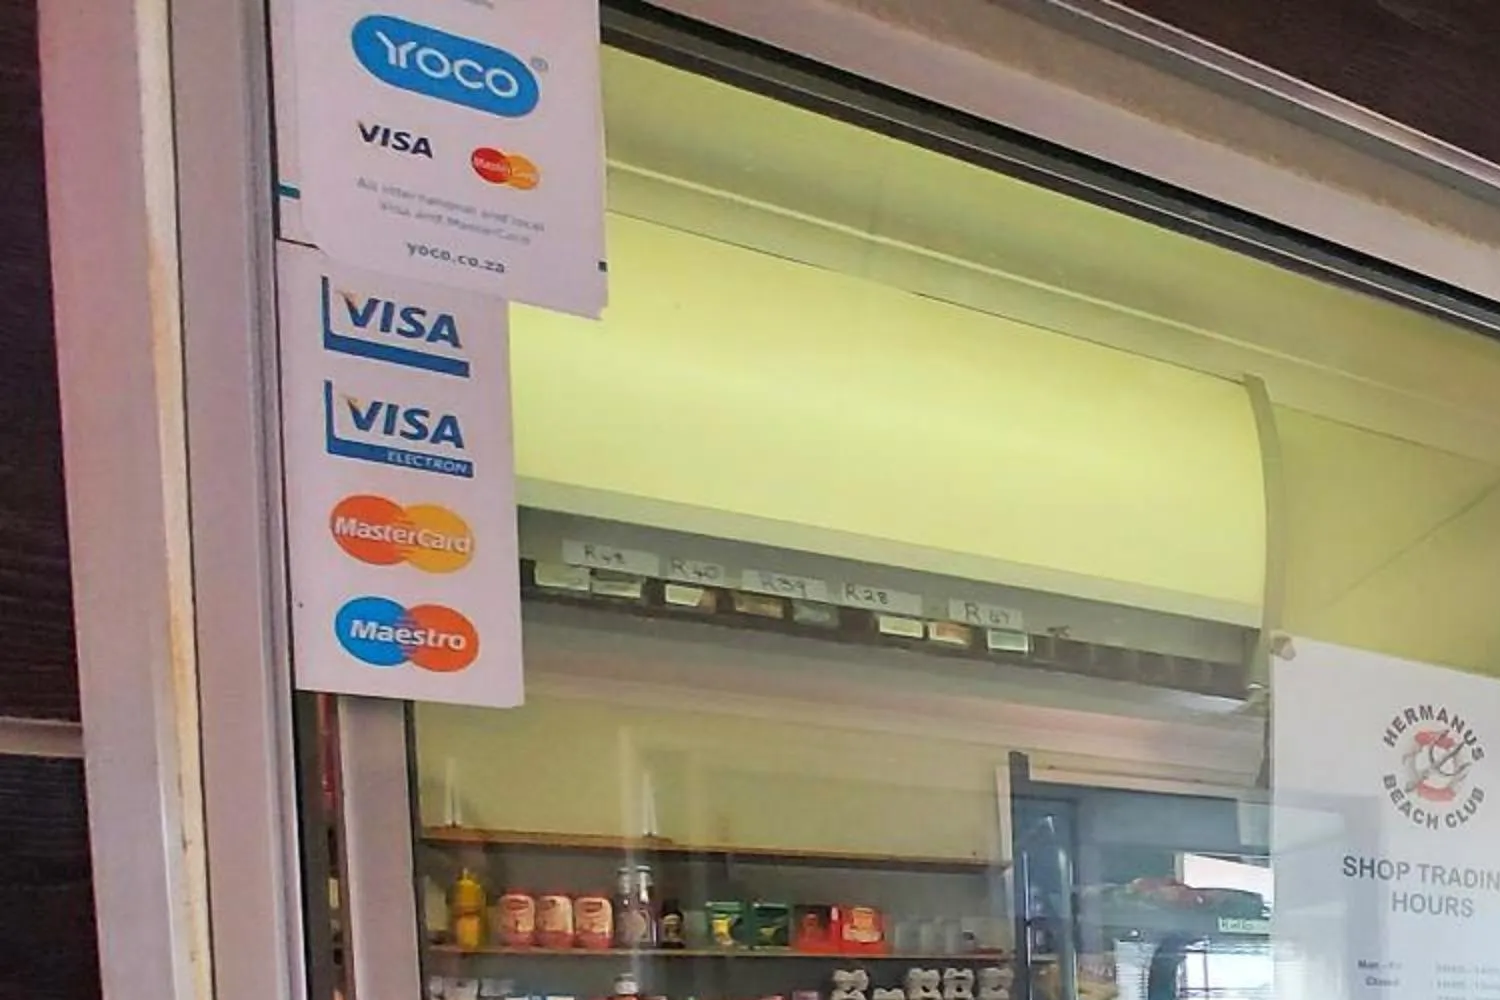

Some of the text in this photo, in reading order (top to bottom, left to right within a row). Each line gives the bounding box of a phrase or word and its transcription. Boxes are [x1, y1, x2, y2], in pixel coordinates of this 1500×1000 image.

[357, 121, 433, 159] VISA
[406, 242, 505, 273] yoco.co.za
[337, 290, 462, 348] VISA
[344, 395, 465, 449] VISA
[386, 452, 469, 475] ELECTRON
[334, 516, 473, 553] MasterCard
[350, 618, 467, 651] Maestro
[1383, 704, 1485, 761] HERMANUS
[1383, 774, 1485, 829] BEACH CLUB
[1342, 855, 1411, 882] SHOP
[1391, 891, 1475, 919] HOURS
